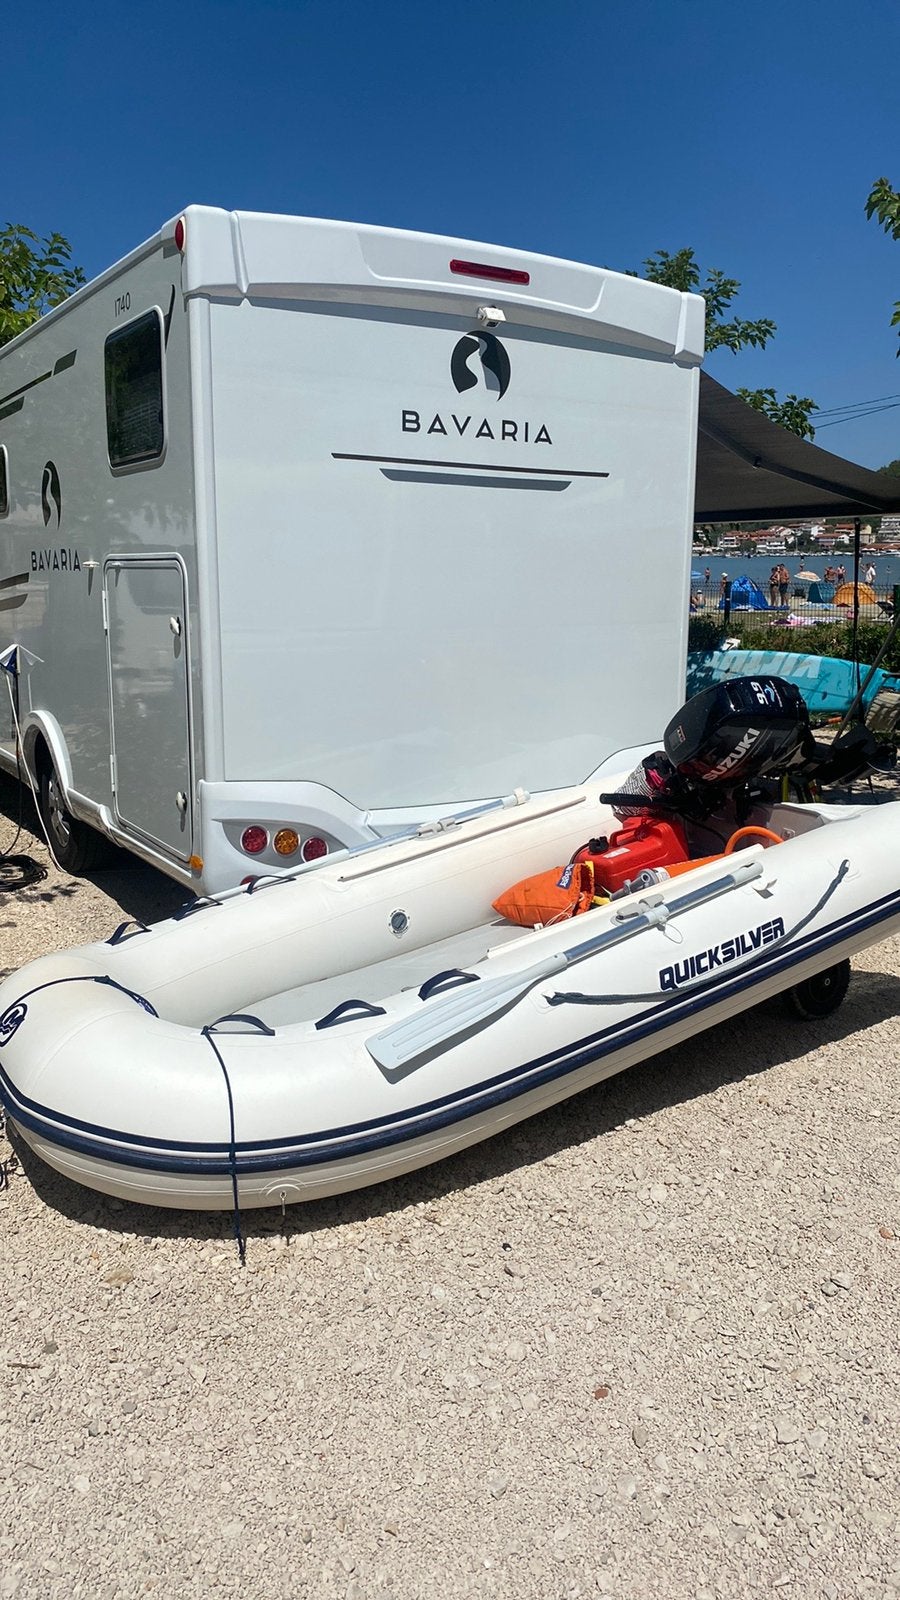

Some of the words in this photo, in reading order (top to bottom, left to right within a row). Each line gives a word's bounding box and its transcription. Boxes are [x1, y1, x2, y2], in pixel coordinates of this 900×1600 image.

[114, 291, 131, 318] 1740
[401, 409, 553, 445] BAVARIA
[31, 549, 82, 572] BAVARIA
[702, 727, 761, 781] SUZUKI
[659, 916, 785, 991] QUICKSILVER
